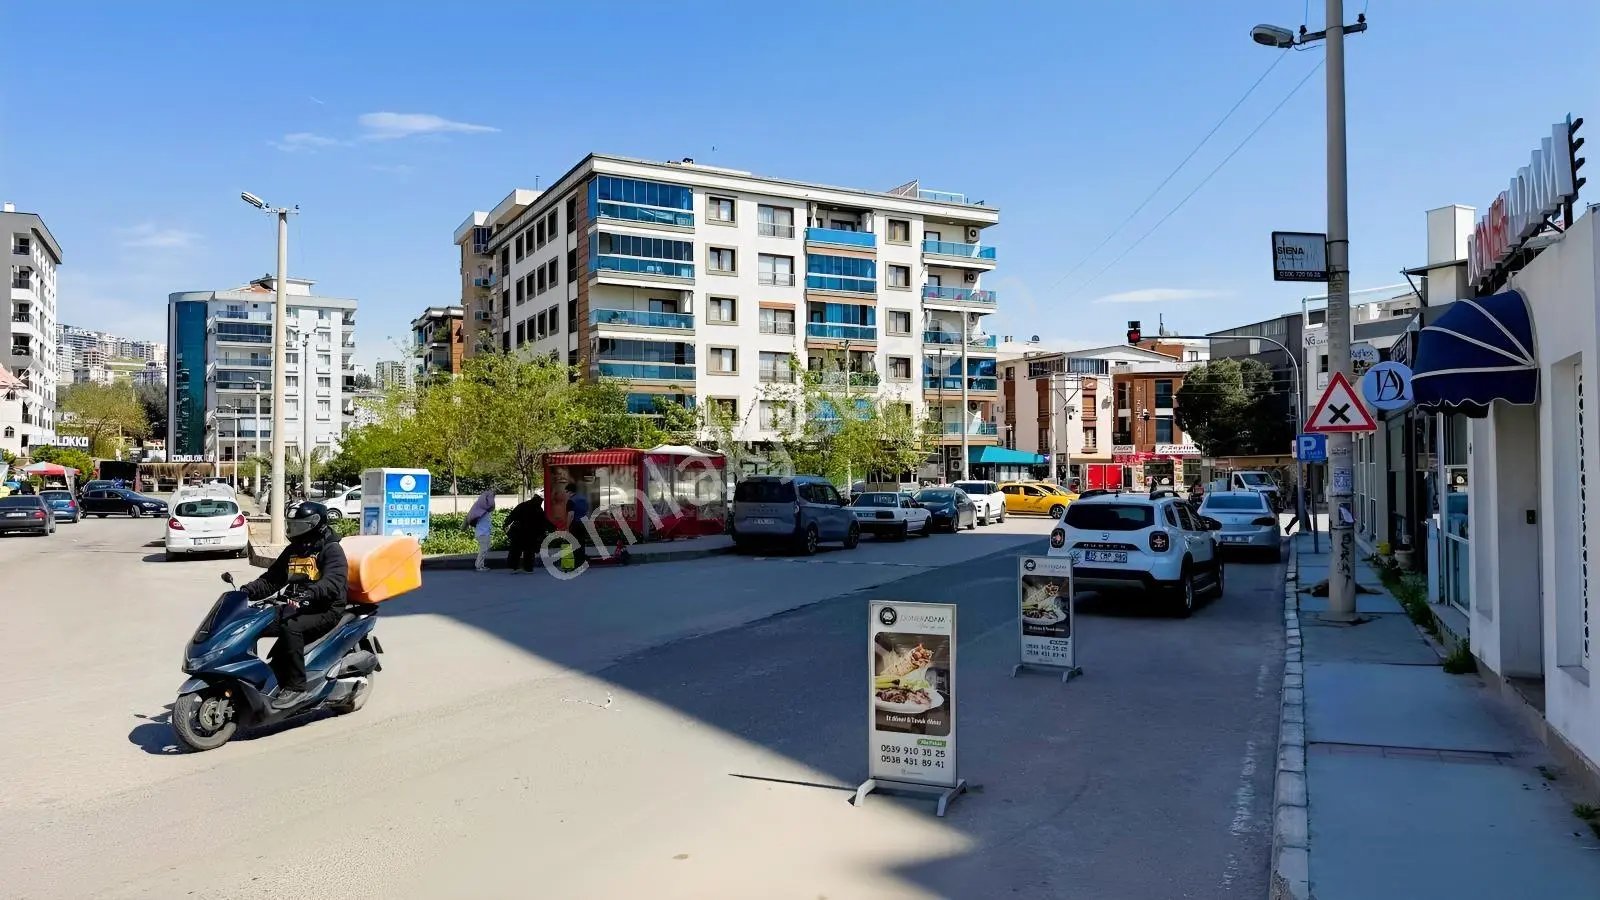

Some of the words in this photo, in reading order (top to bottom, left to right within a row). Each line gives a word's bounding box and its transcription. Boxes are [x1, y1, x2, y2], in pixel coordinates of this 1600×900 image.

[1277, 246, 1304, 255] SIENA
[1298, 436, 1316, 459] P
[880, 744, 901, 753] 0539
[903, 746, 919, 755] 910
[935, 750, 946, 758] 25
[881, 755, 901, 764] 0538
[904, 757, 918, 766] 431
[922, 759, 932, 767] 89
[935, 761, 944, 769] 41
